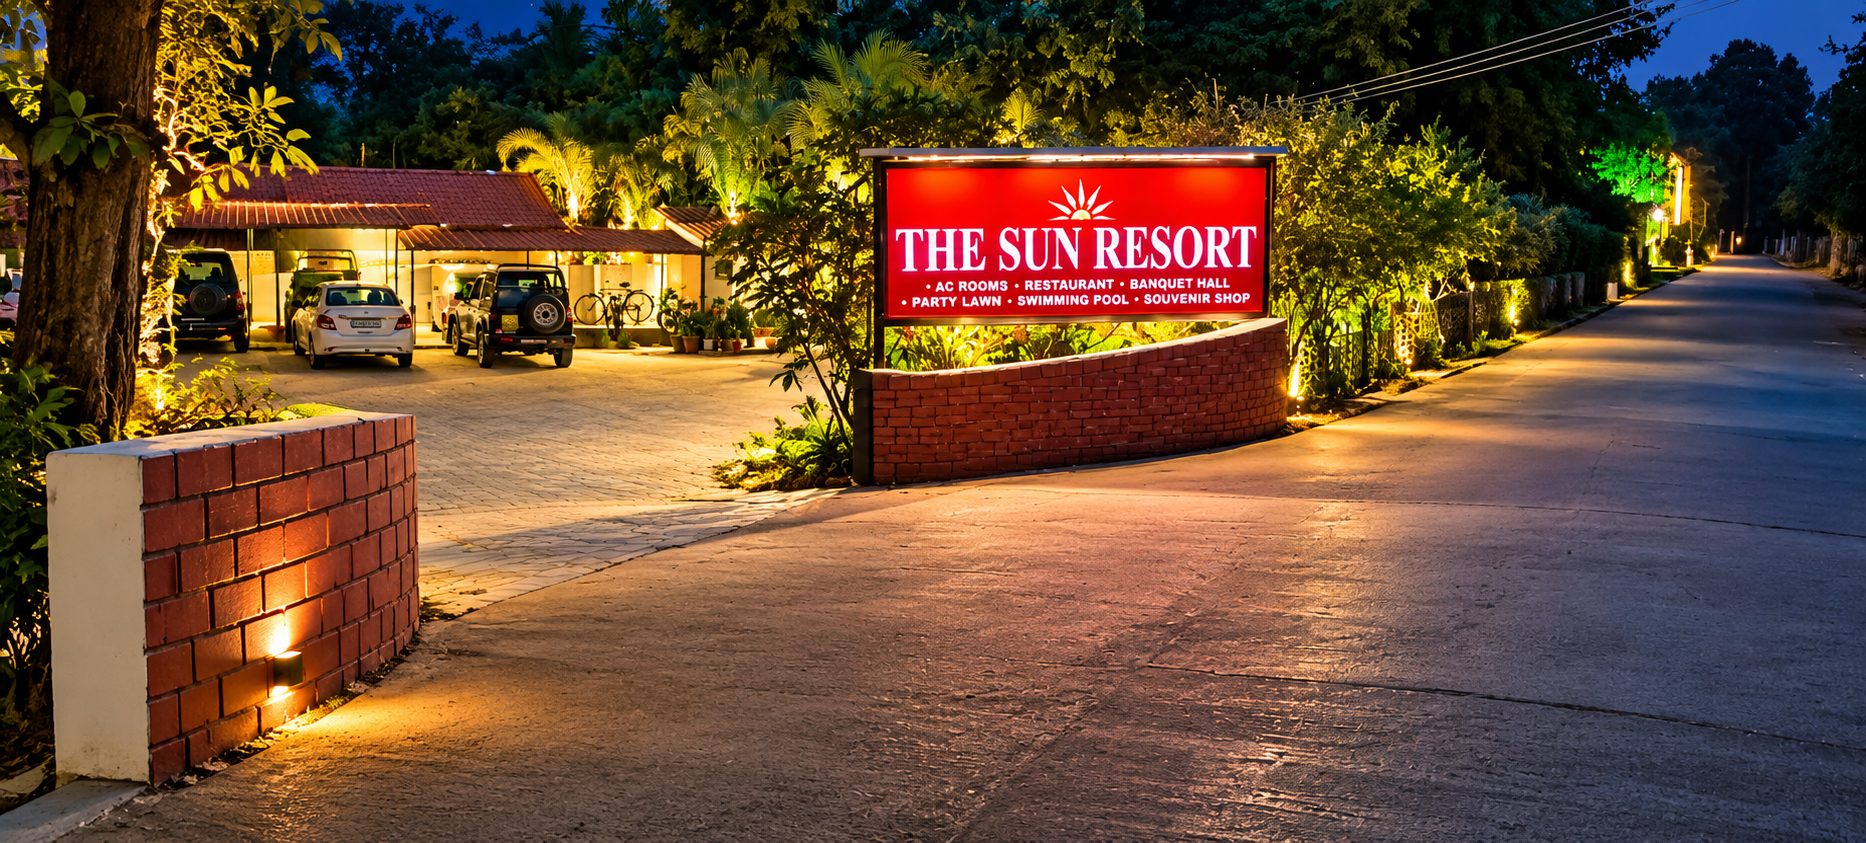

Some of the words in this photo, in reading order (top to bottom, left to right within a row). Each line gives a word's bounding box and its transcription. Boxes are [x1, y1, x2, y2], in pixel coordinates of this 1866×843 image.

[895, 228, 987, 272] THE
[998, 227, 1083, 272] SUN
[1092, 225, 1257, 270] RESORT
[935, 281, 954, 292] AC
[958, 280, 1009, 292] ROOMS
[1024, 279, 1115, 291] RESTAURANT
[1129, 278, 1194, 291] BANQUET
[1197, 277, 1231, 289] HALL
[911, 296, 958, 308] PARTY
[962, 295, 1002, 307] LAWN
[1017, 294, 1090, 306] SWIMMING
[1093, 294, 1130, 305] POOL
[1143, 293, 1211, 305] SOUVENIR
[1214, 292, 1251, 304] SHOP
